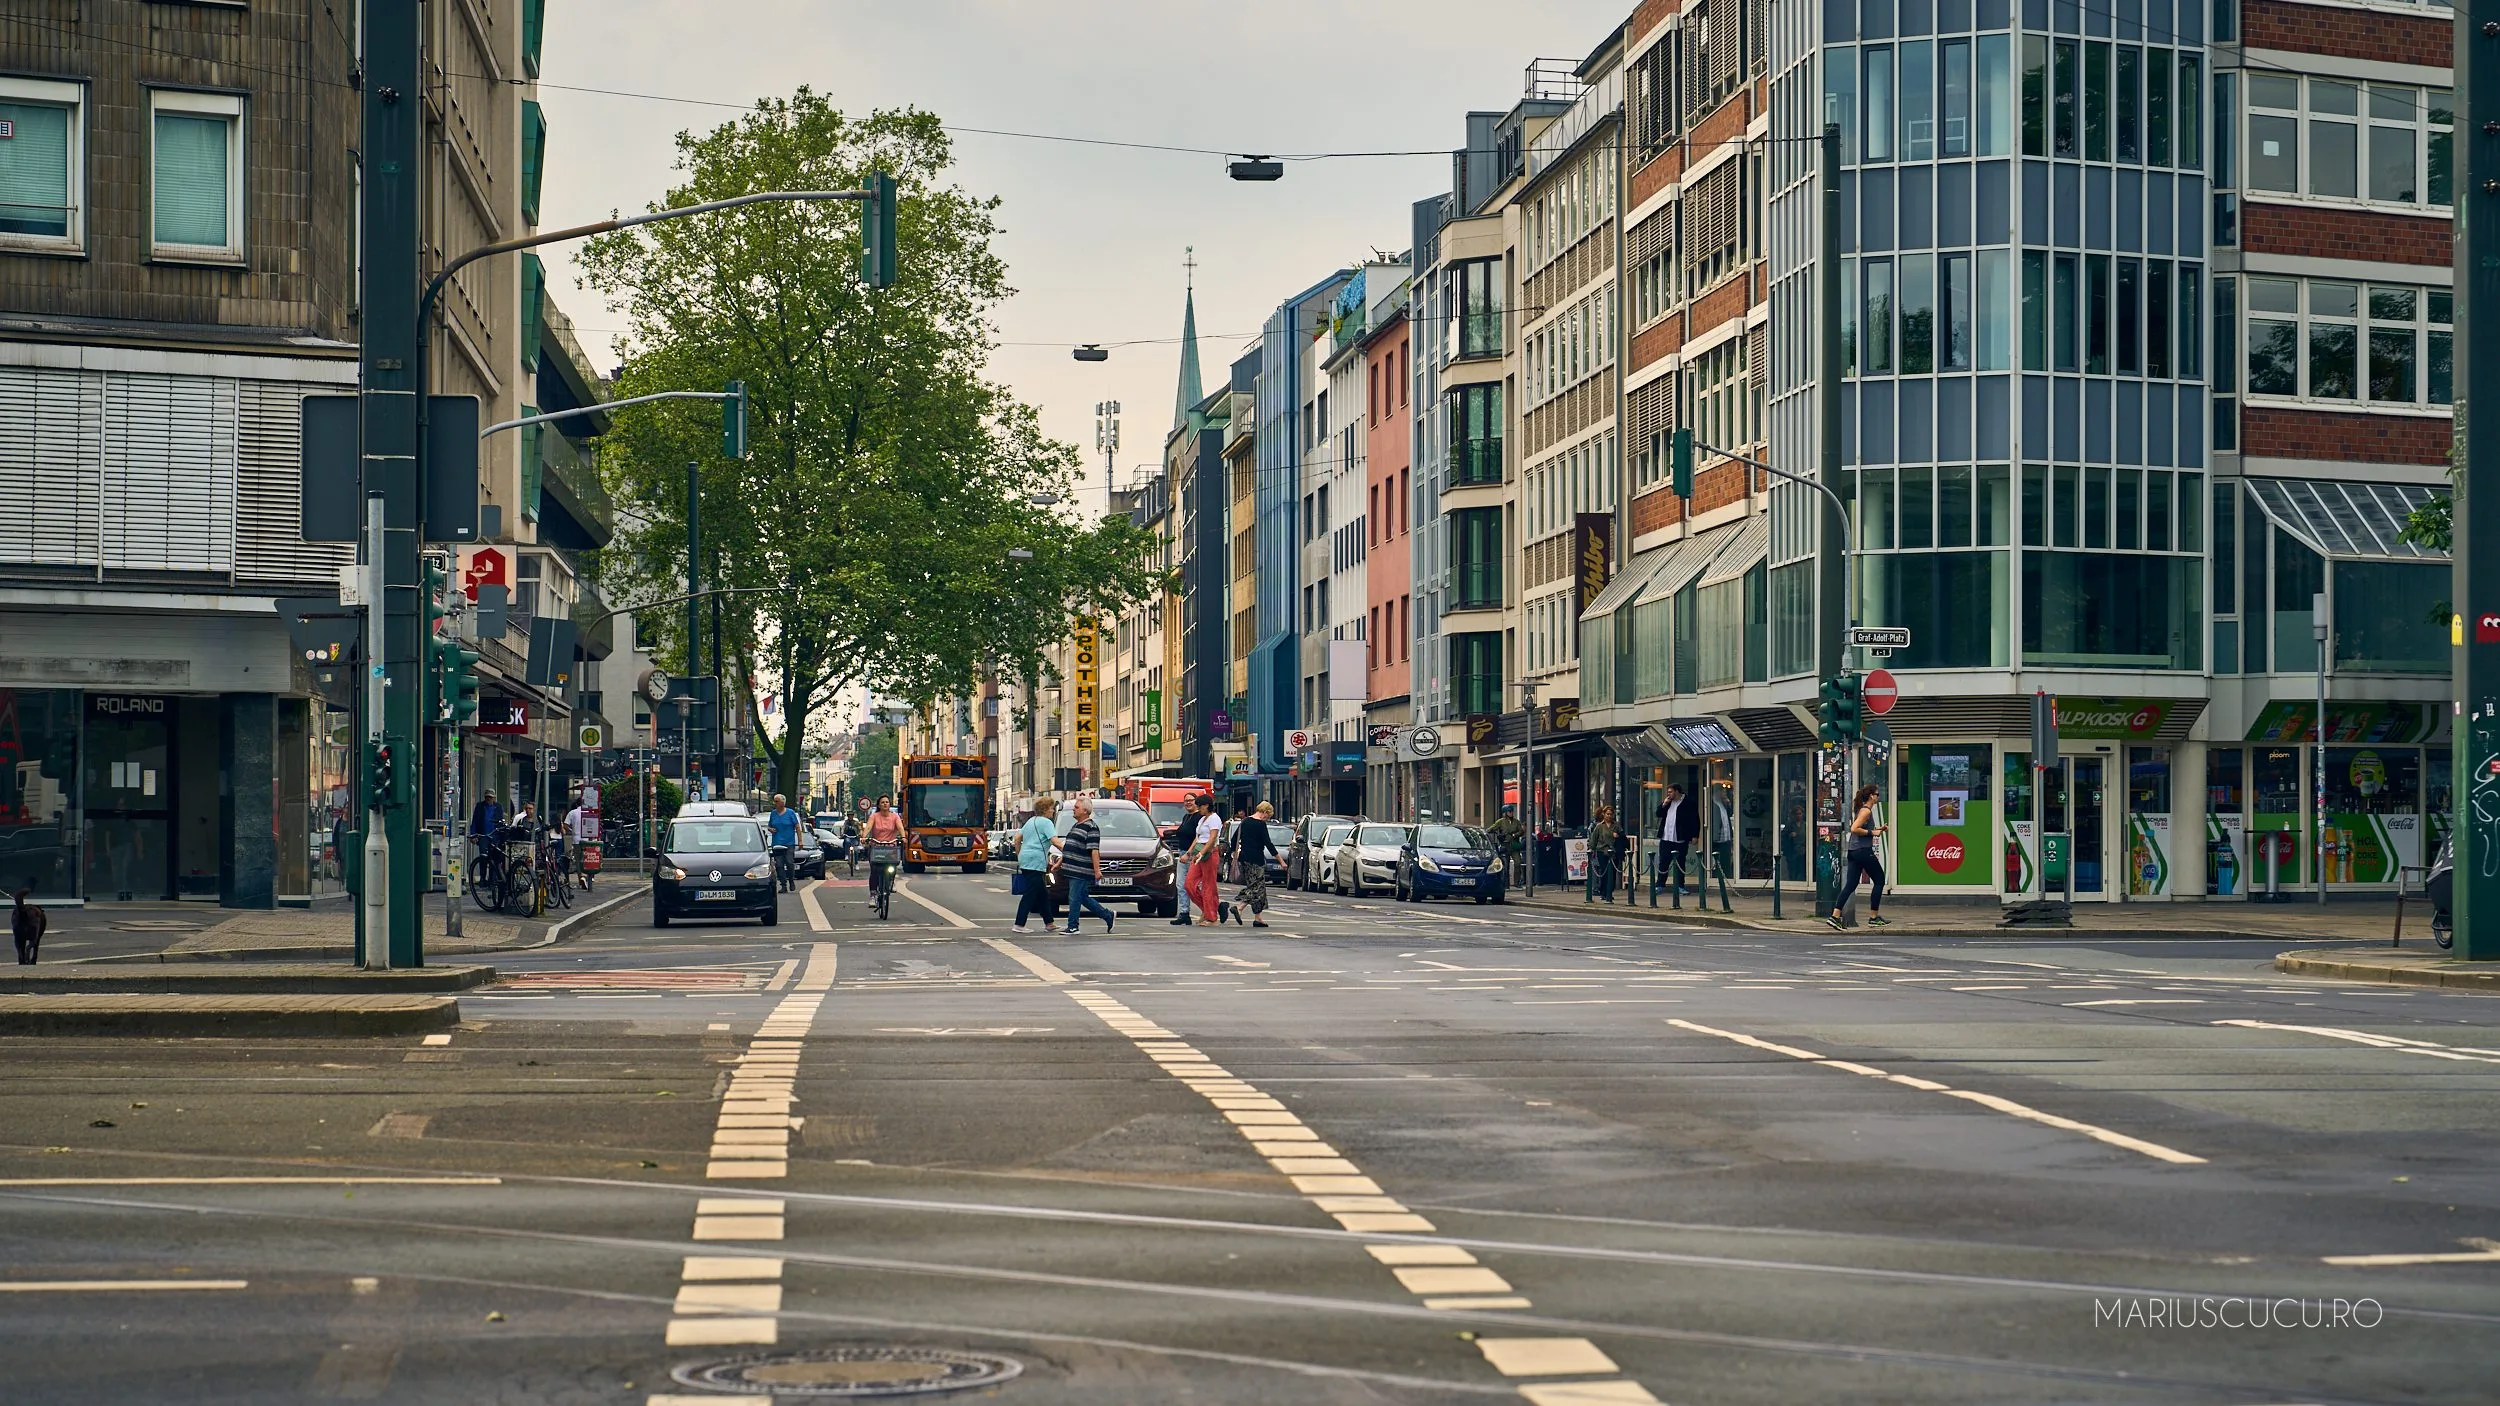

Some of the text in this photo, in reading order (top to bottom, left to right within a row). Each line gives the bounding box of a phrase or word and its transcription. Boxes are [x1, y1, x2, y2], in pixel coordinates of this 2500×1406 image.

[1858, 633, 1905, 643] Graf-Adolf-Platz
[97, 697, 164, 714] ROLAND
[2083, 712, 2134, 726] KIOSK
